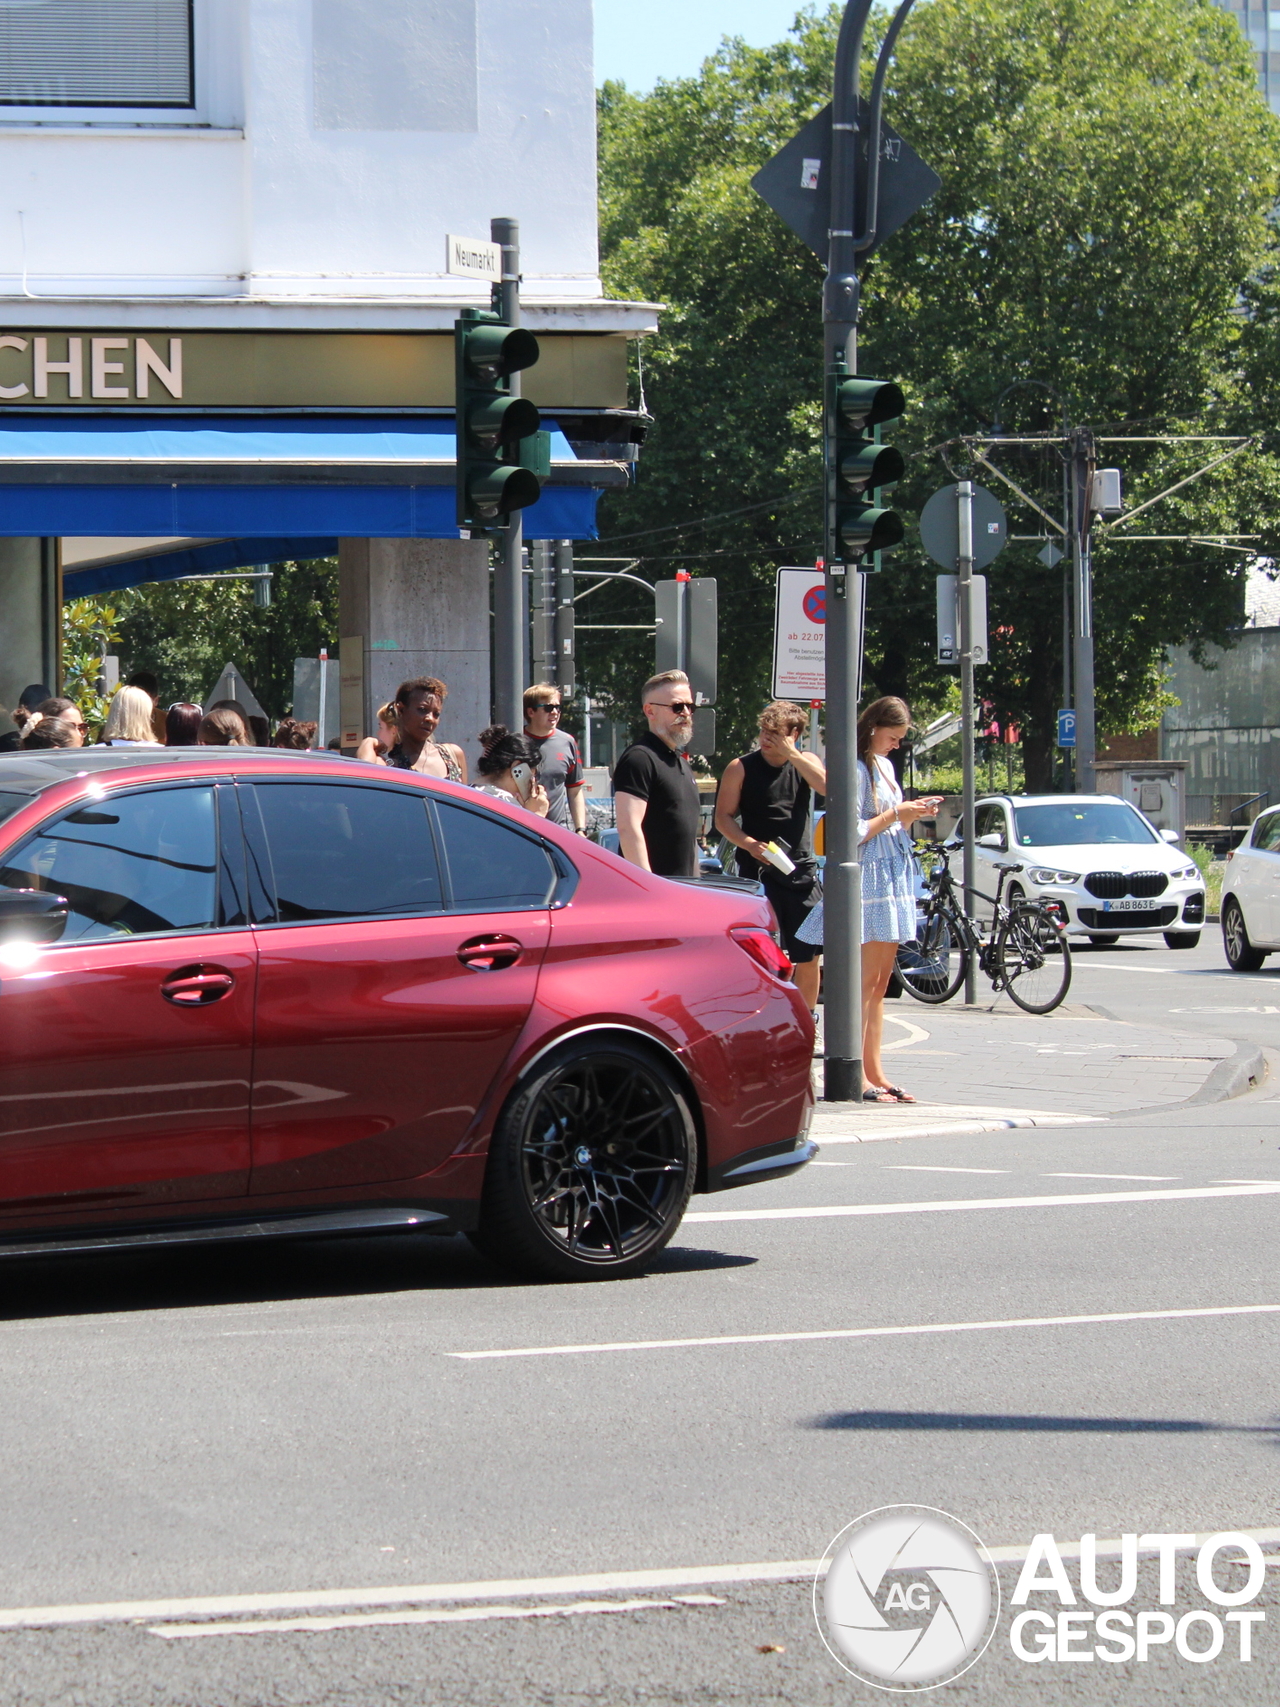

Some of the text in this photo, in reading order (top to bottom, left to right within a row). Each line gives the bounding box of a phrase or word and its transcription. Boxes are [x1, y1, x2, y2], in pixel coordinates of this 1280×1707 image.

[455, 243, 495, 272] Neumarkt
[787, 632, 798, 641] ab
[1065, 718, 1075, 733] P
[1120, 901, 1130, 910] AB
